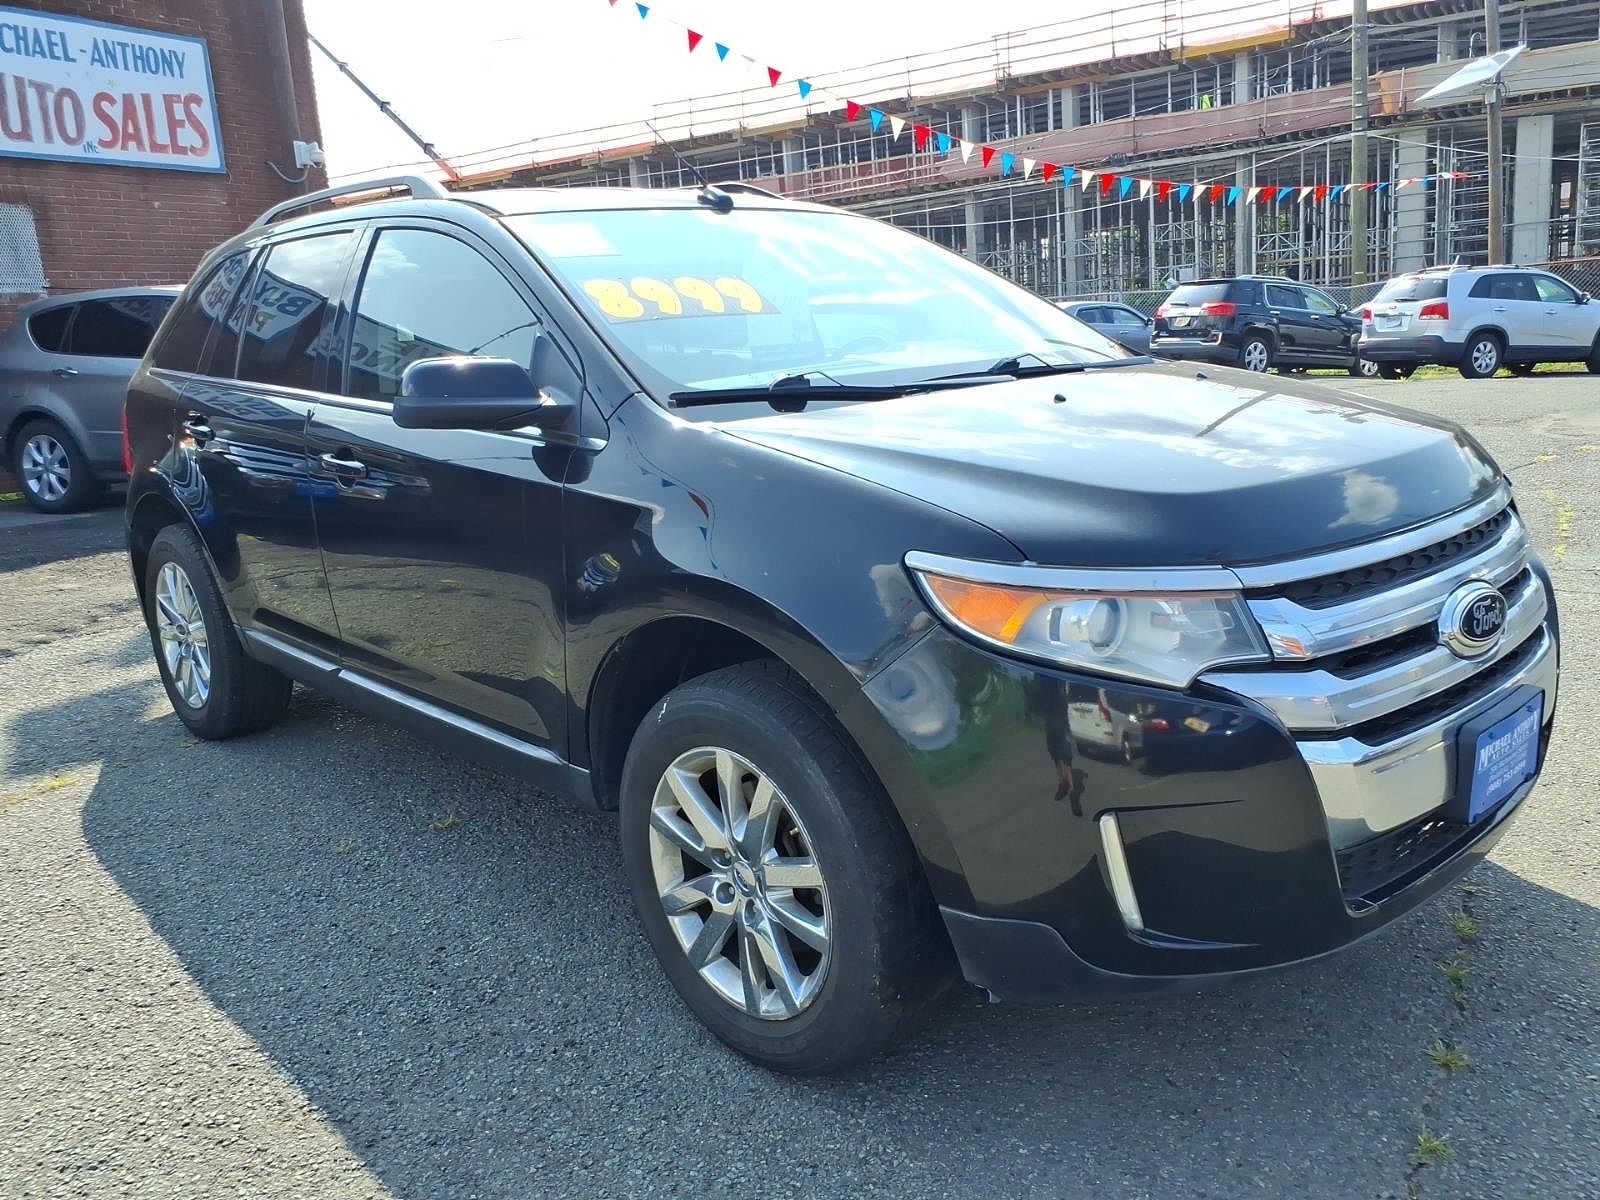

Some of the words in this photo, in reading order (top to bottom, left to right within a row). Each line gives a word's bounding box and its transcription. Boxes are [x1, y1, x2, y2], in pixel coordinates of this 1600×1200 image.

[92, 91, 210, 157] SALES
[584, 277, 761, 318] 8999
[1473, 598, 1502, 634] Ford
